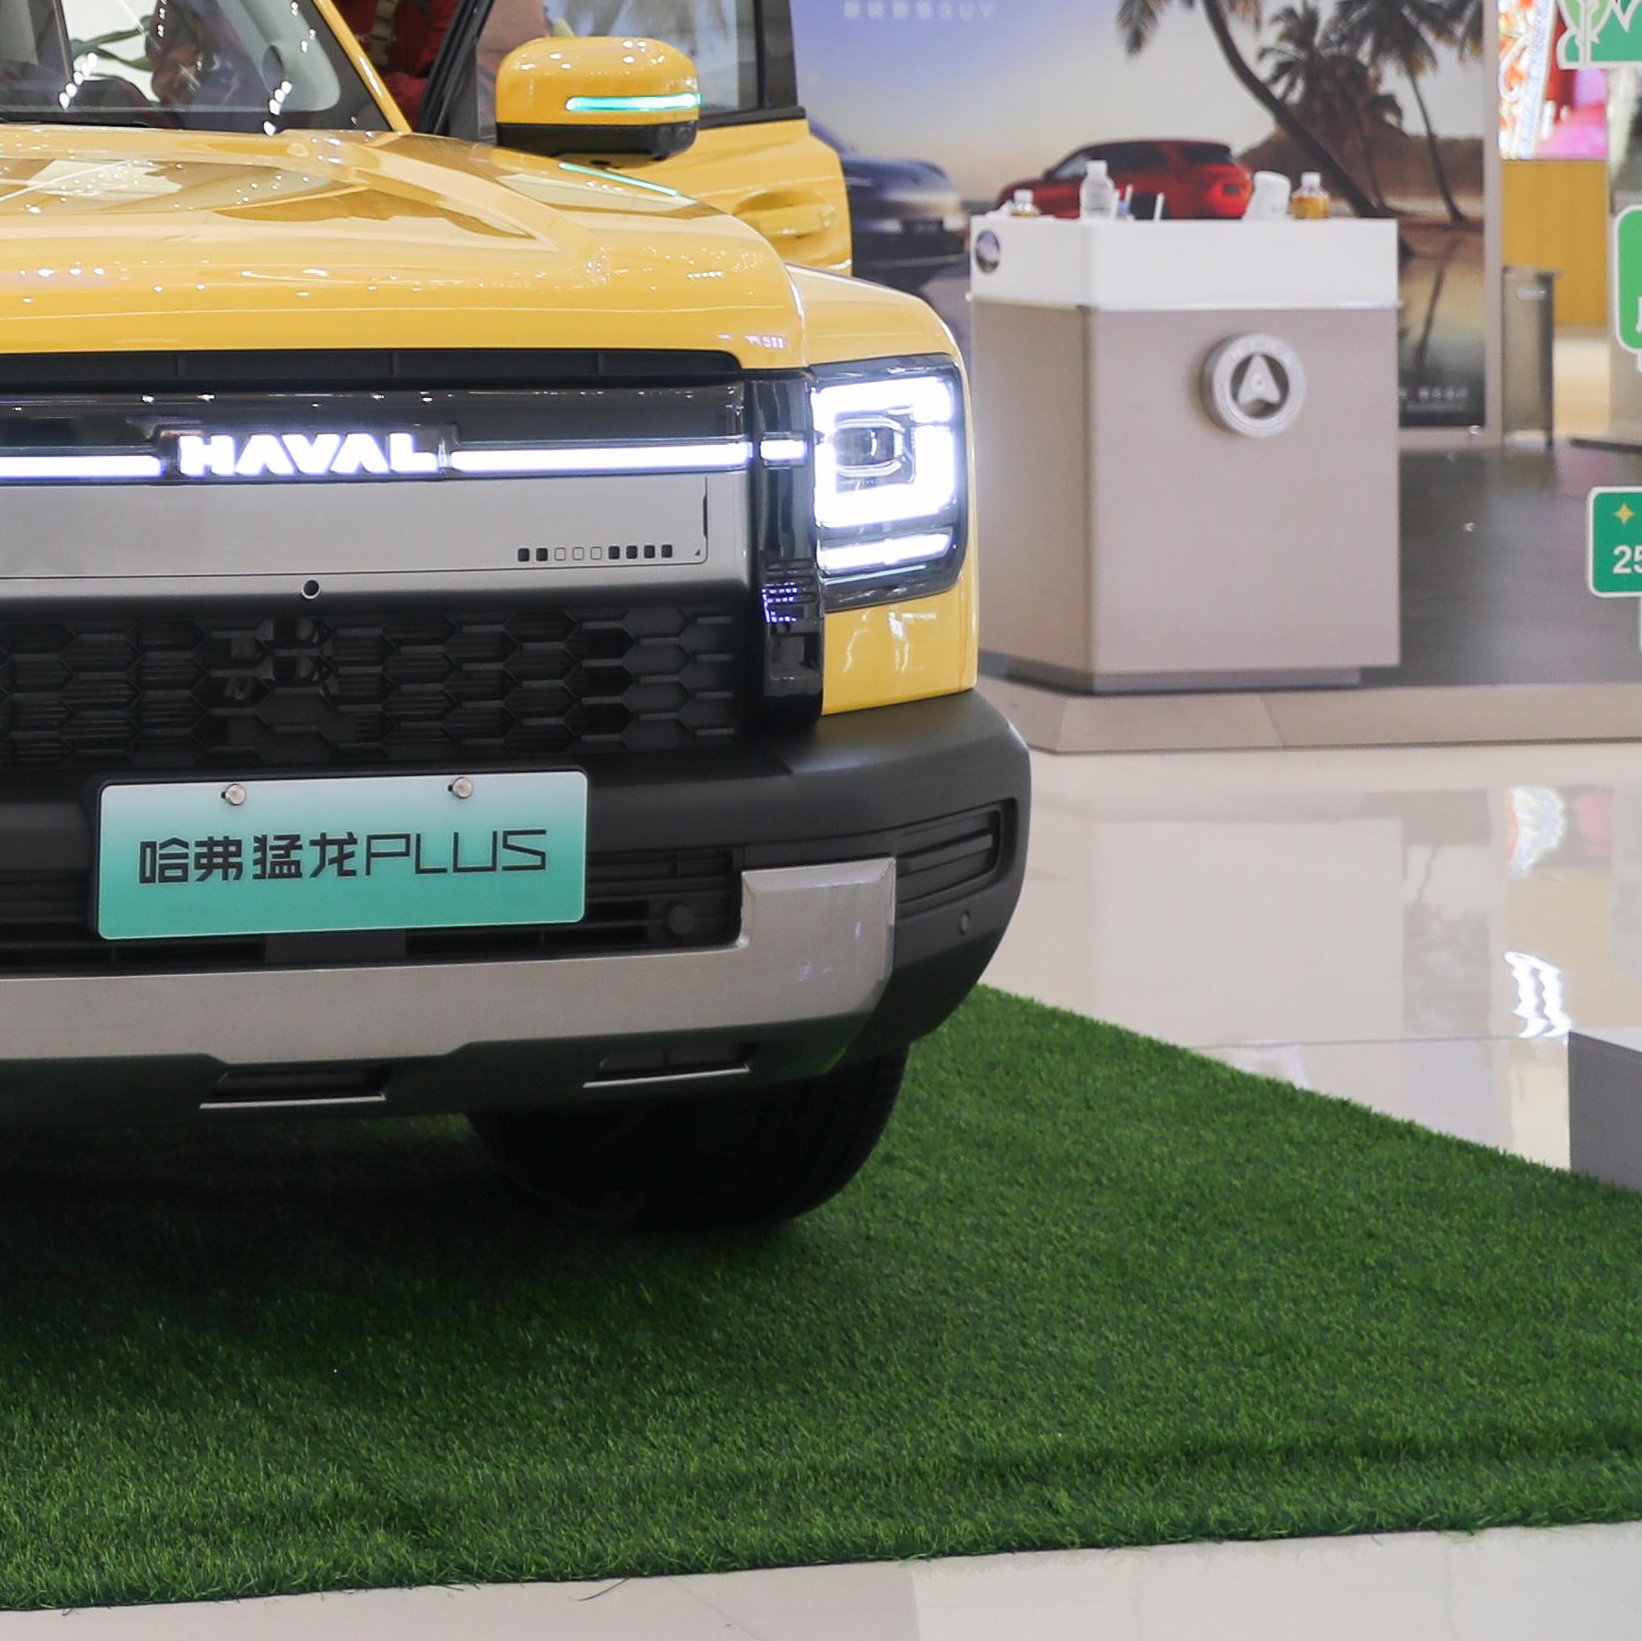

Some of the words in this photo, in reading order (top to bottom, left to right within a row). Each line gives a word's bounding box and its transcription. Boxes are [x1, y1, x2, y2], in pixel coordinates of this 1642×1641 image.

[178, 431, 439, 477] HAVAL
[138, 829, 547, 884] 哈弗猛龙PLUS
